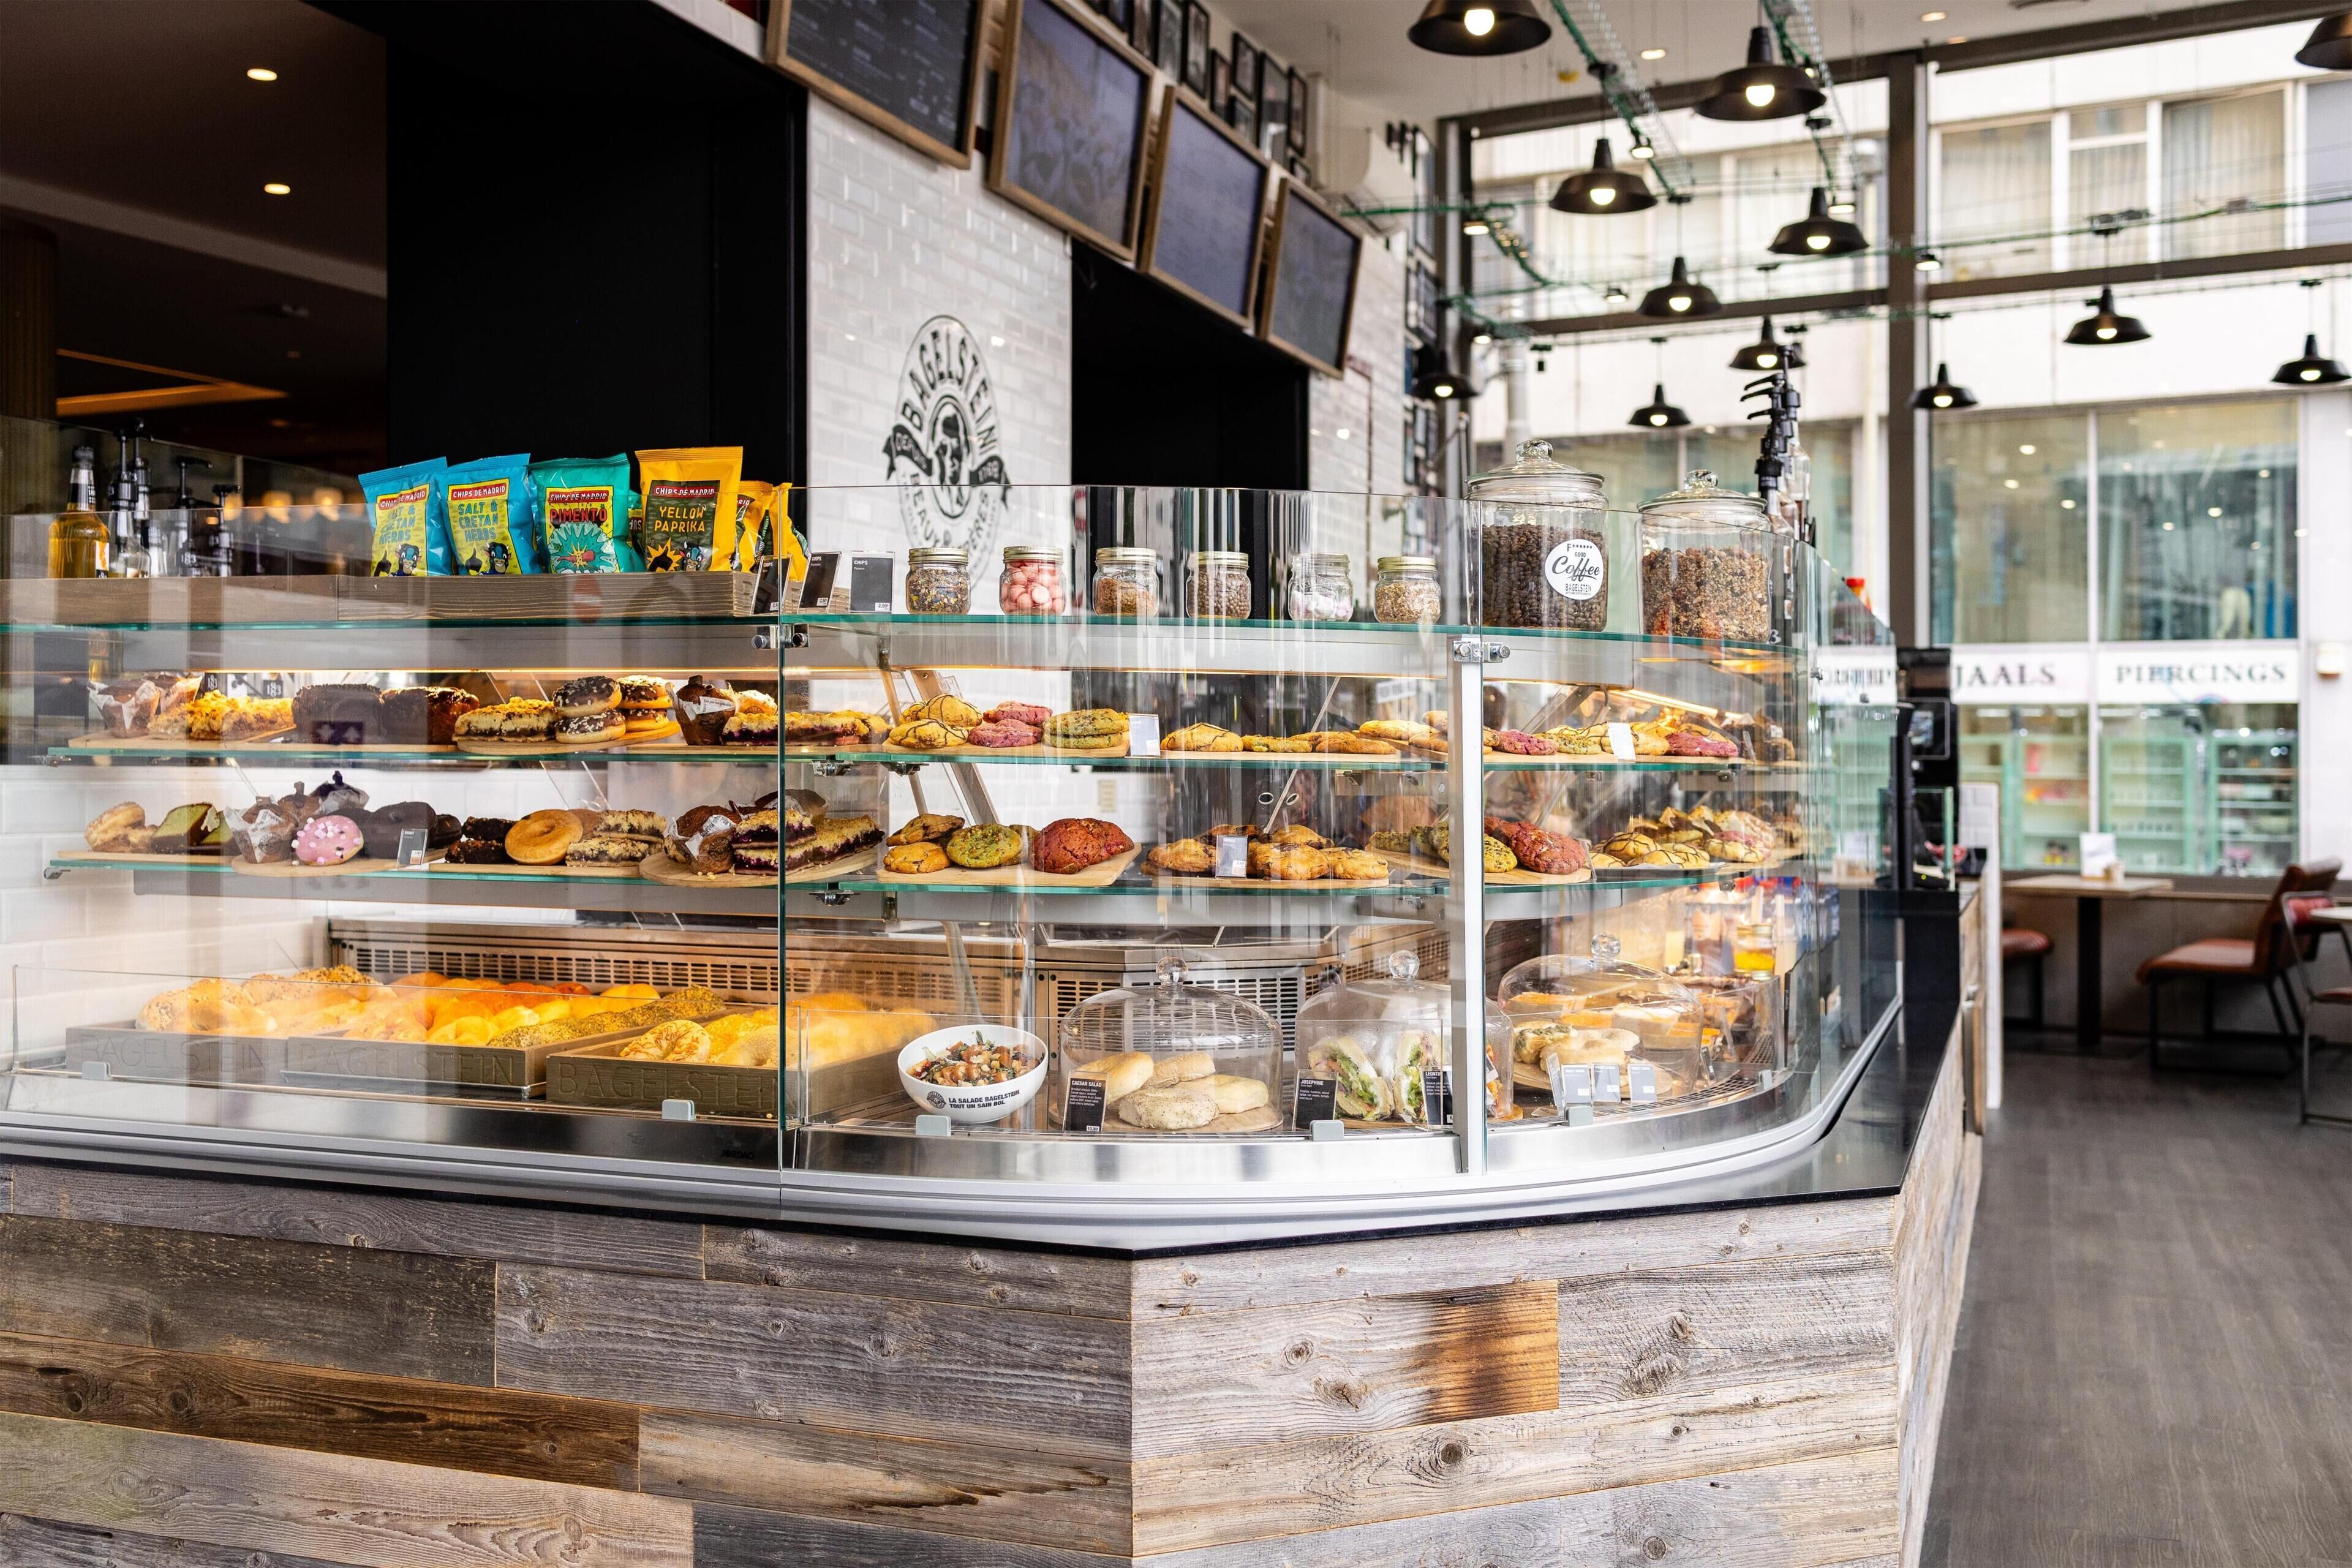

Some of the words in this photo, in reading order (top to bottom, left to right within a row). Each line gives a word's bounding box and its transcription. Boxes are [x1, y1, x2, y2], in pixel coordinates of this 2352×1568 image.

[901, 328, 998, 456] BAGELSTEIN
[405, 491, 426, 501] MADRID
[483, 485, 506, 496] MADRID
[458, 502, 486, 516] SALT
[490, 500, 499, 513] &
[549, 507, 608, 523] PIMENTO
[659, 505, 704, 520] YELLOW
[458, 513, 499, 530] CRETAN
[654, 520, 706, 533] PAPRIKA
[464, 527, 497, 543] HERBS
[1552, 556, 1600, 582] Coffee
[1565, 583, 1592, 593] BAGELSTEIN
[2116, 663, 2287, 685] PIERCINGS
[985, 1090, 1020, 1102] BAGELSTEIN
